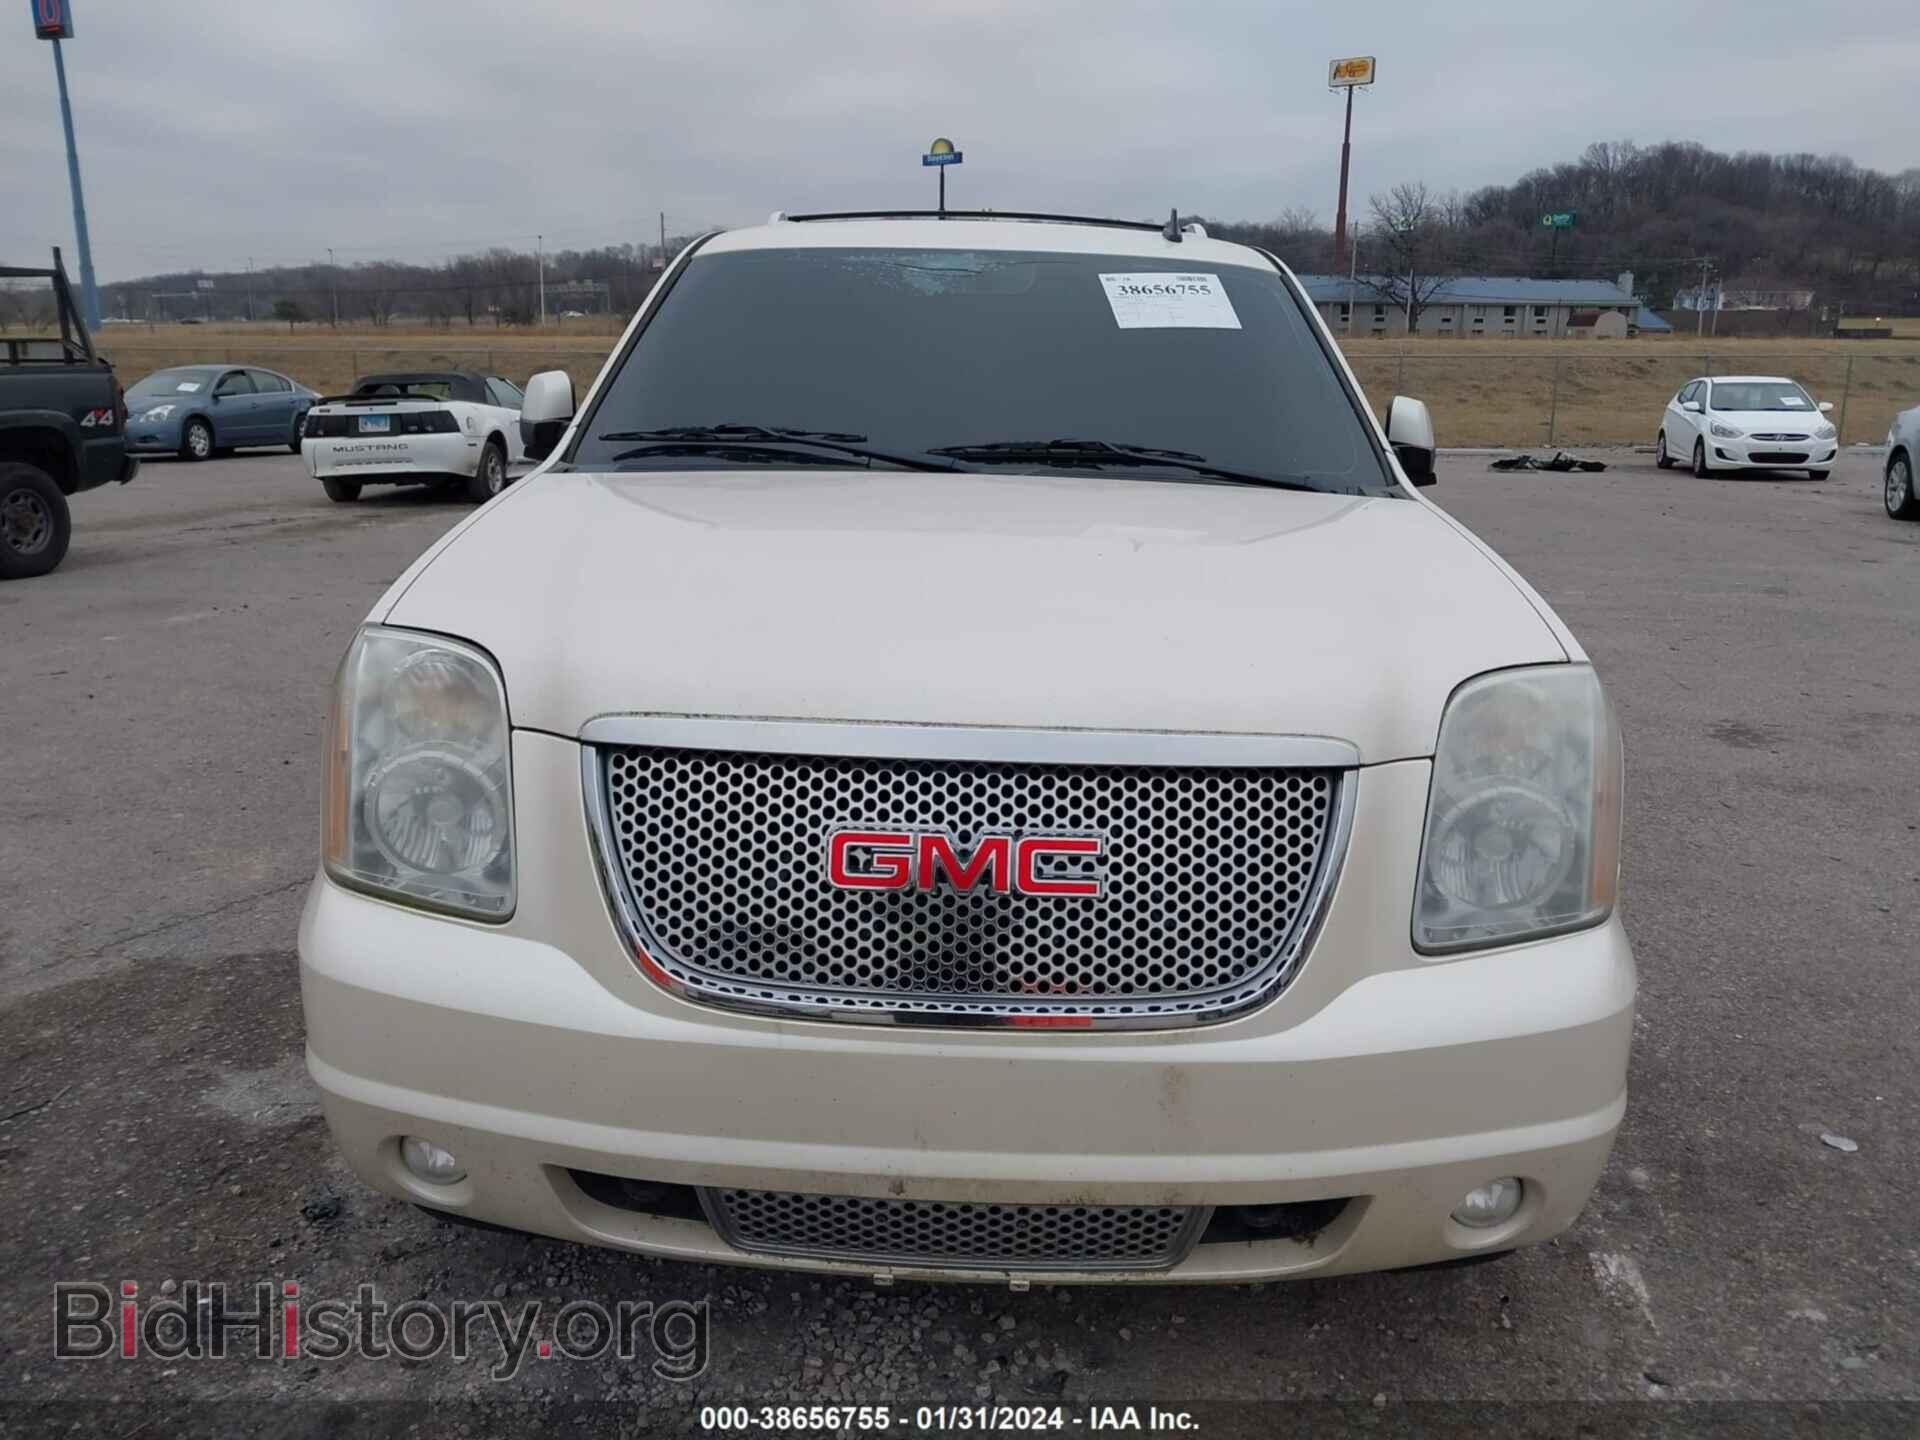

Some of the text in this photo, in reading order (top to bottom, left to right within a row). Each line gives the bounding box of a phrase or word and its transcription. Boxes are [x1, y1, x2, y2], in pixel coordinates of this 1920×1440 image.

[1118, 284, 1212, 296] 38656755
[332, 443, 409, 453] MUSTANG
[827, 830, 1103, 899] GMC
